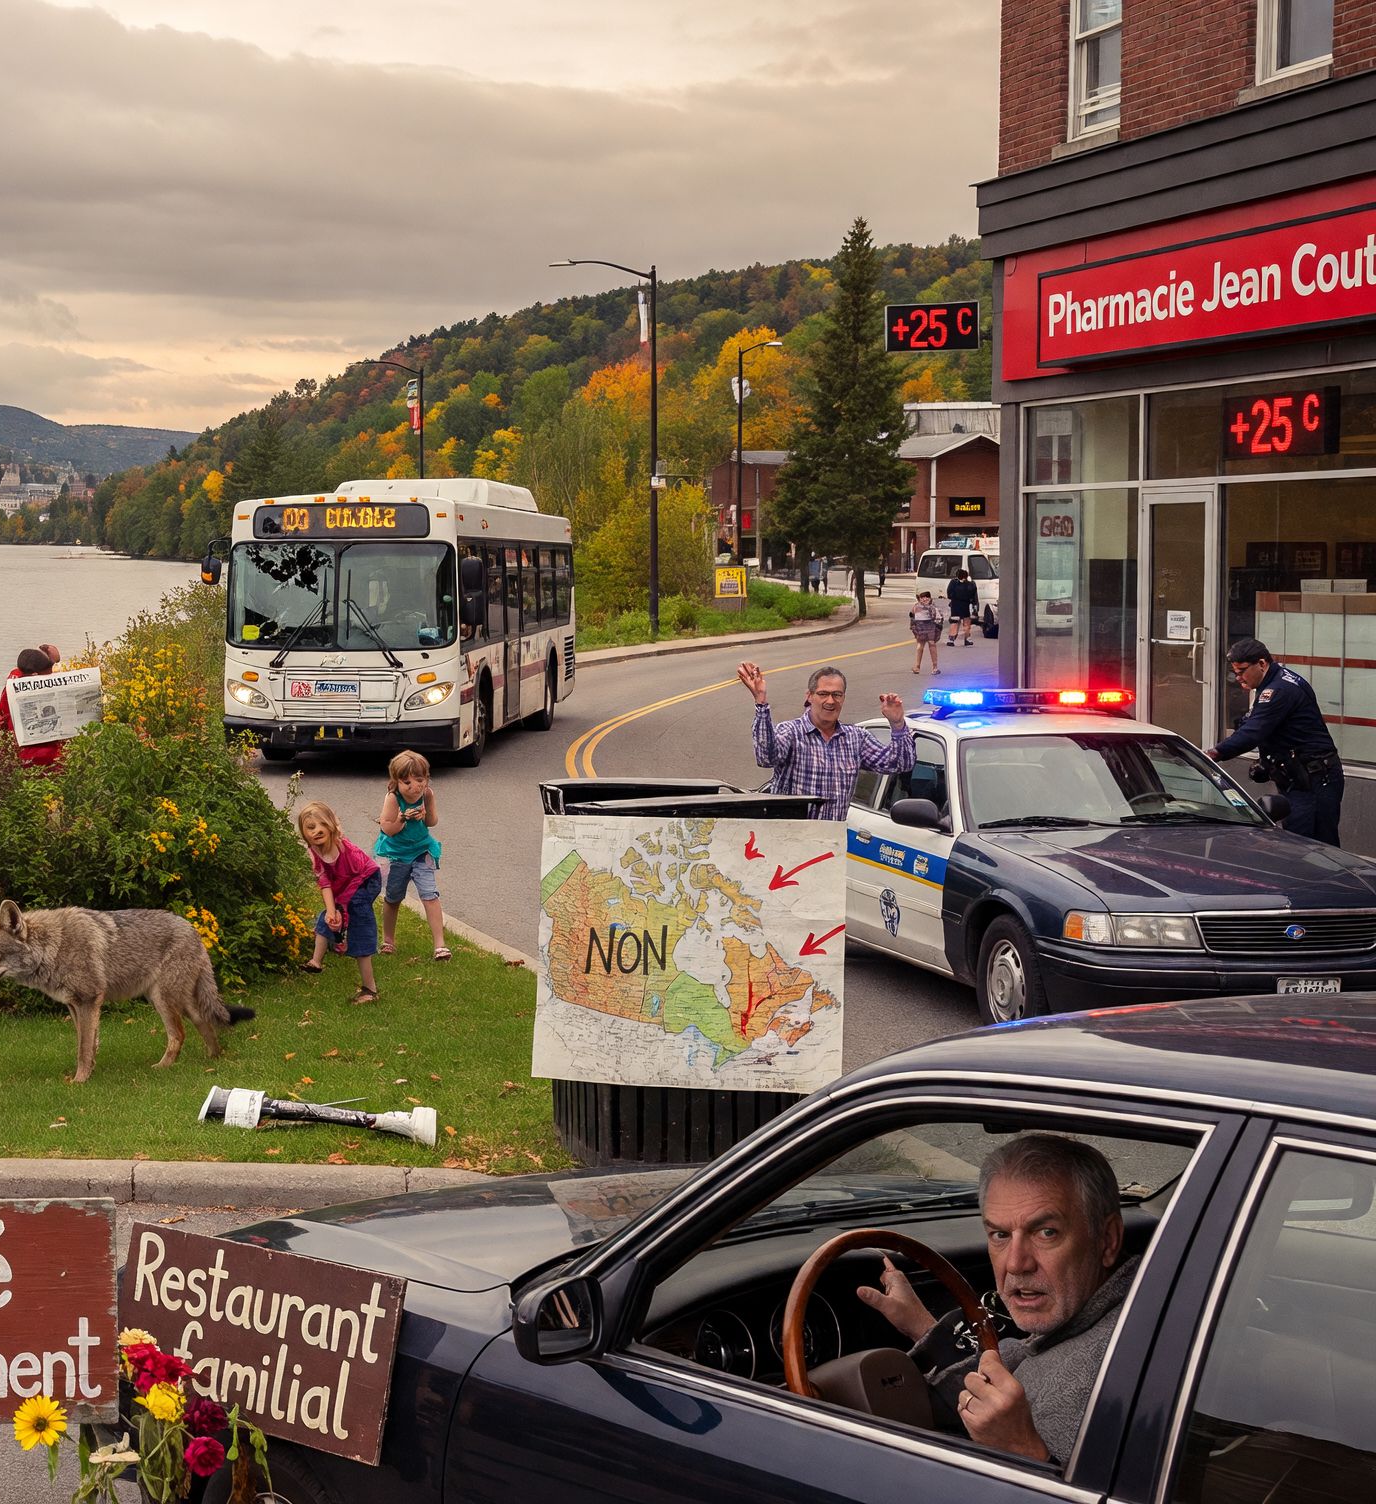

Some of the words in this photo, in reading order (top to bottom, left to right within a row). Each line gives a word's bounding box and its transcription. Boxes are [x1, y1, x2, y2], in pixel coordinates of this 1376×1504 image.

[1048, 270, 1195, 338] Pharmacie
[1201, 261, 1282, 312] Jean
[1291, 233, 1376, 297] Cout
[891, 308, 948, 348] +25
[957, 307, 973, 336] C
[1230, 397, 1293, 454] +25
[1303, 393, 1320, 432] C
[584, 924, 668, 976] NON
[134, 1231, 387, 1364] Restaurant
[173, 1320, 351, 1440] familial
